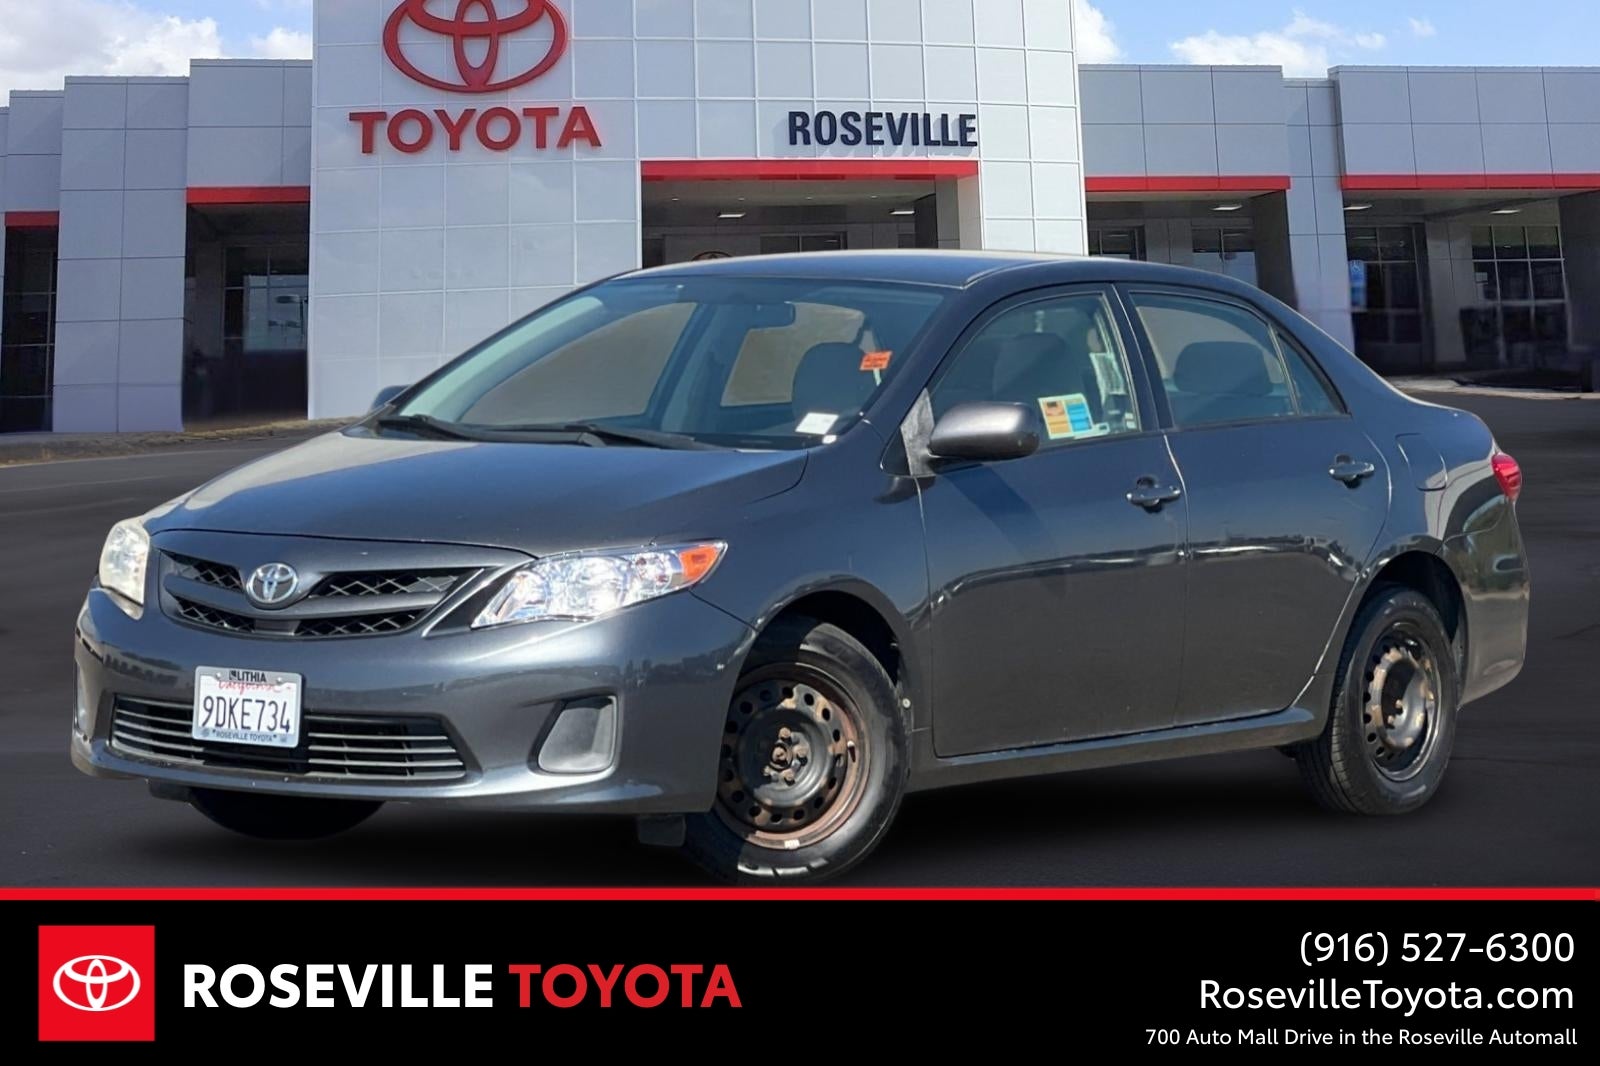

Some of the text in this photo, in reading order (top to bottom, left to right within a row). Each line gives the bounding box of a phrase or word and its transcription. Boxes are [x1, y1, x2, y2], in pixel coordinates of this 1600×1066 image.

[349, 106, 602, 154] TOYOTA
[788, 110, 978, 147] ROSEVILLE
[237, 671, 267, 683] LITHIA
[202, 695, 291, 733] 9DKE734
[216, 731, 273, 742] ROSEVILLE TOYOTA
